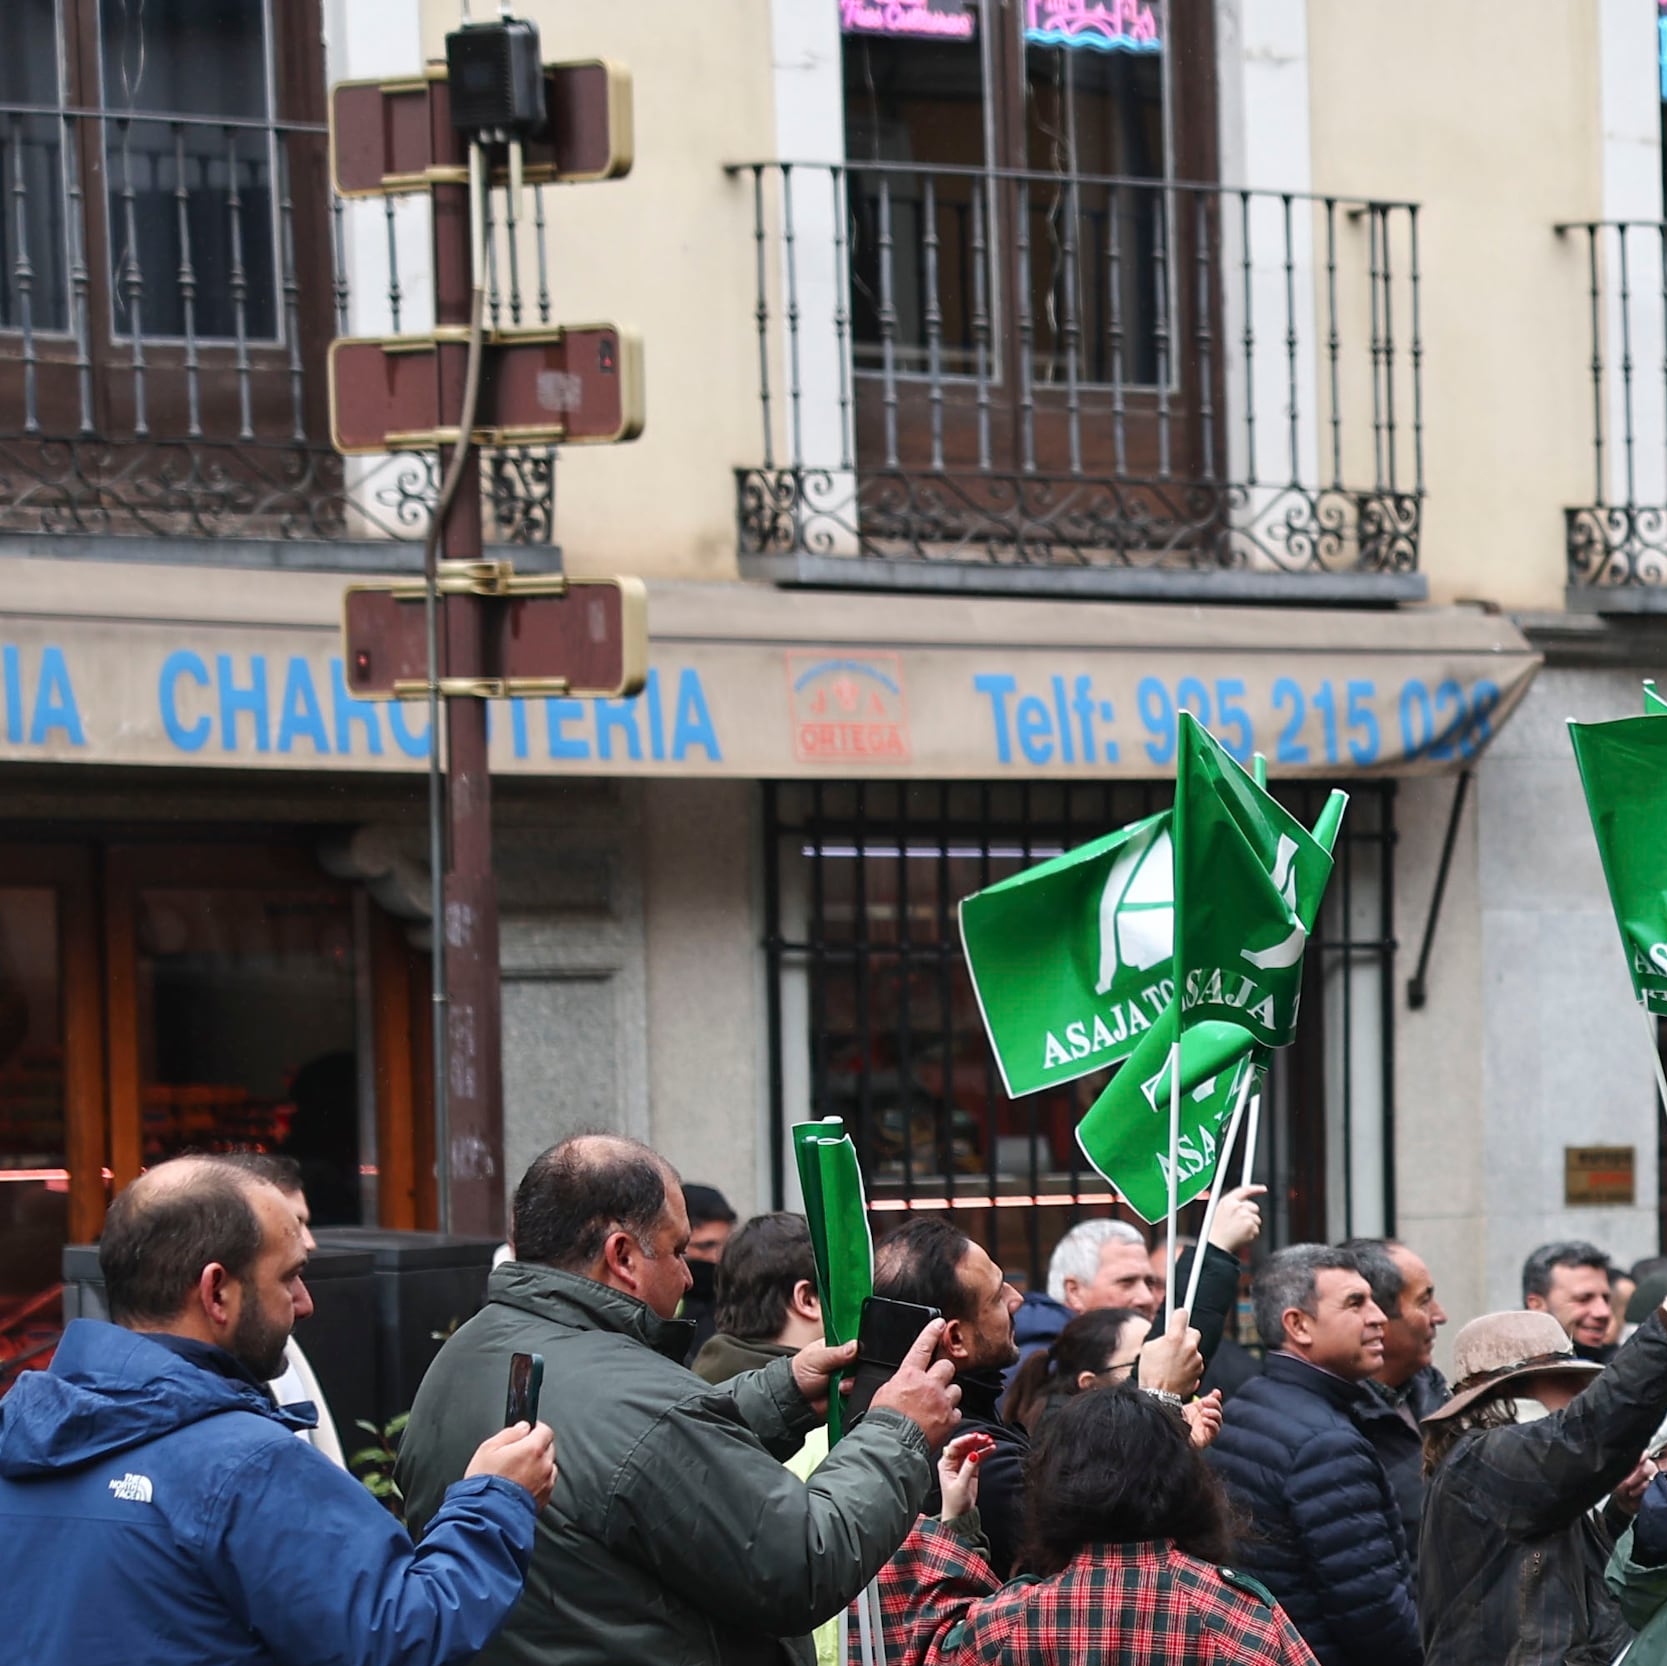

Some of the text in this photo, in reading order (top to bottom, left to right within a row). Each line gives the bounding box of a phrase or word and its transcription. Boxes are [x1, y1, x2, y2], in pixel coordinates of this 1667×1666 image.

[973, 674, 1119, 765] Telf:
[1272, 679, 1381, 765] 215
[1043, 999, 1152, 1069] ASAJA
